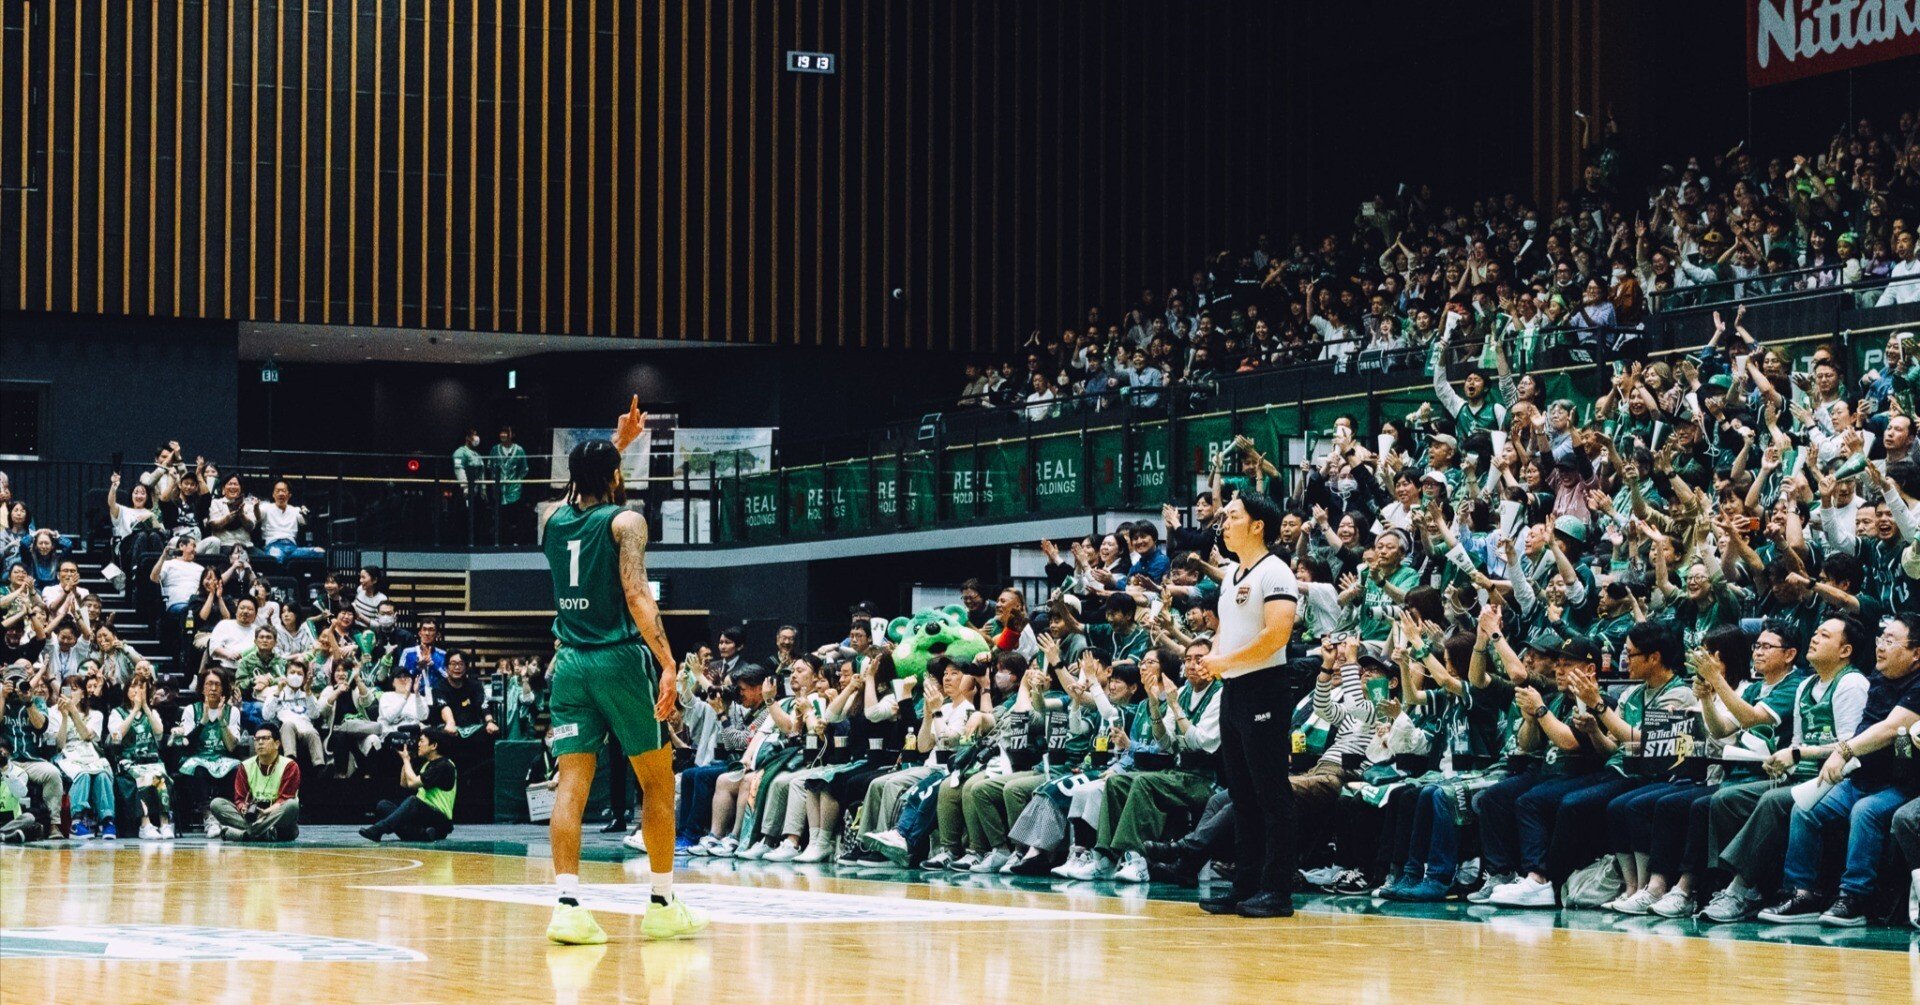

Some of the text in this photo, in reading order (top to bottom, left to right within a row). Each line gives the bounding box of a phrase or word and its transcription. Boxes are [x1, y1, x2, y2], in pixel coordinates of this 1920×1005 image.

[878, 479, 917, 500] REL
[953, 470, 993, 490] REL
[566, 540, 582, 588] 1
[559, 598, 590, 610] BOYD
